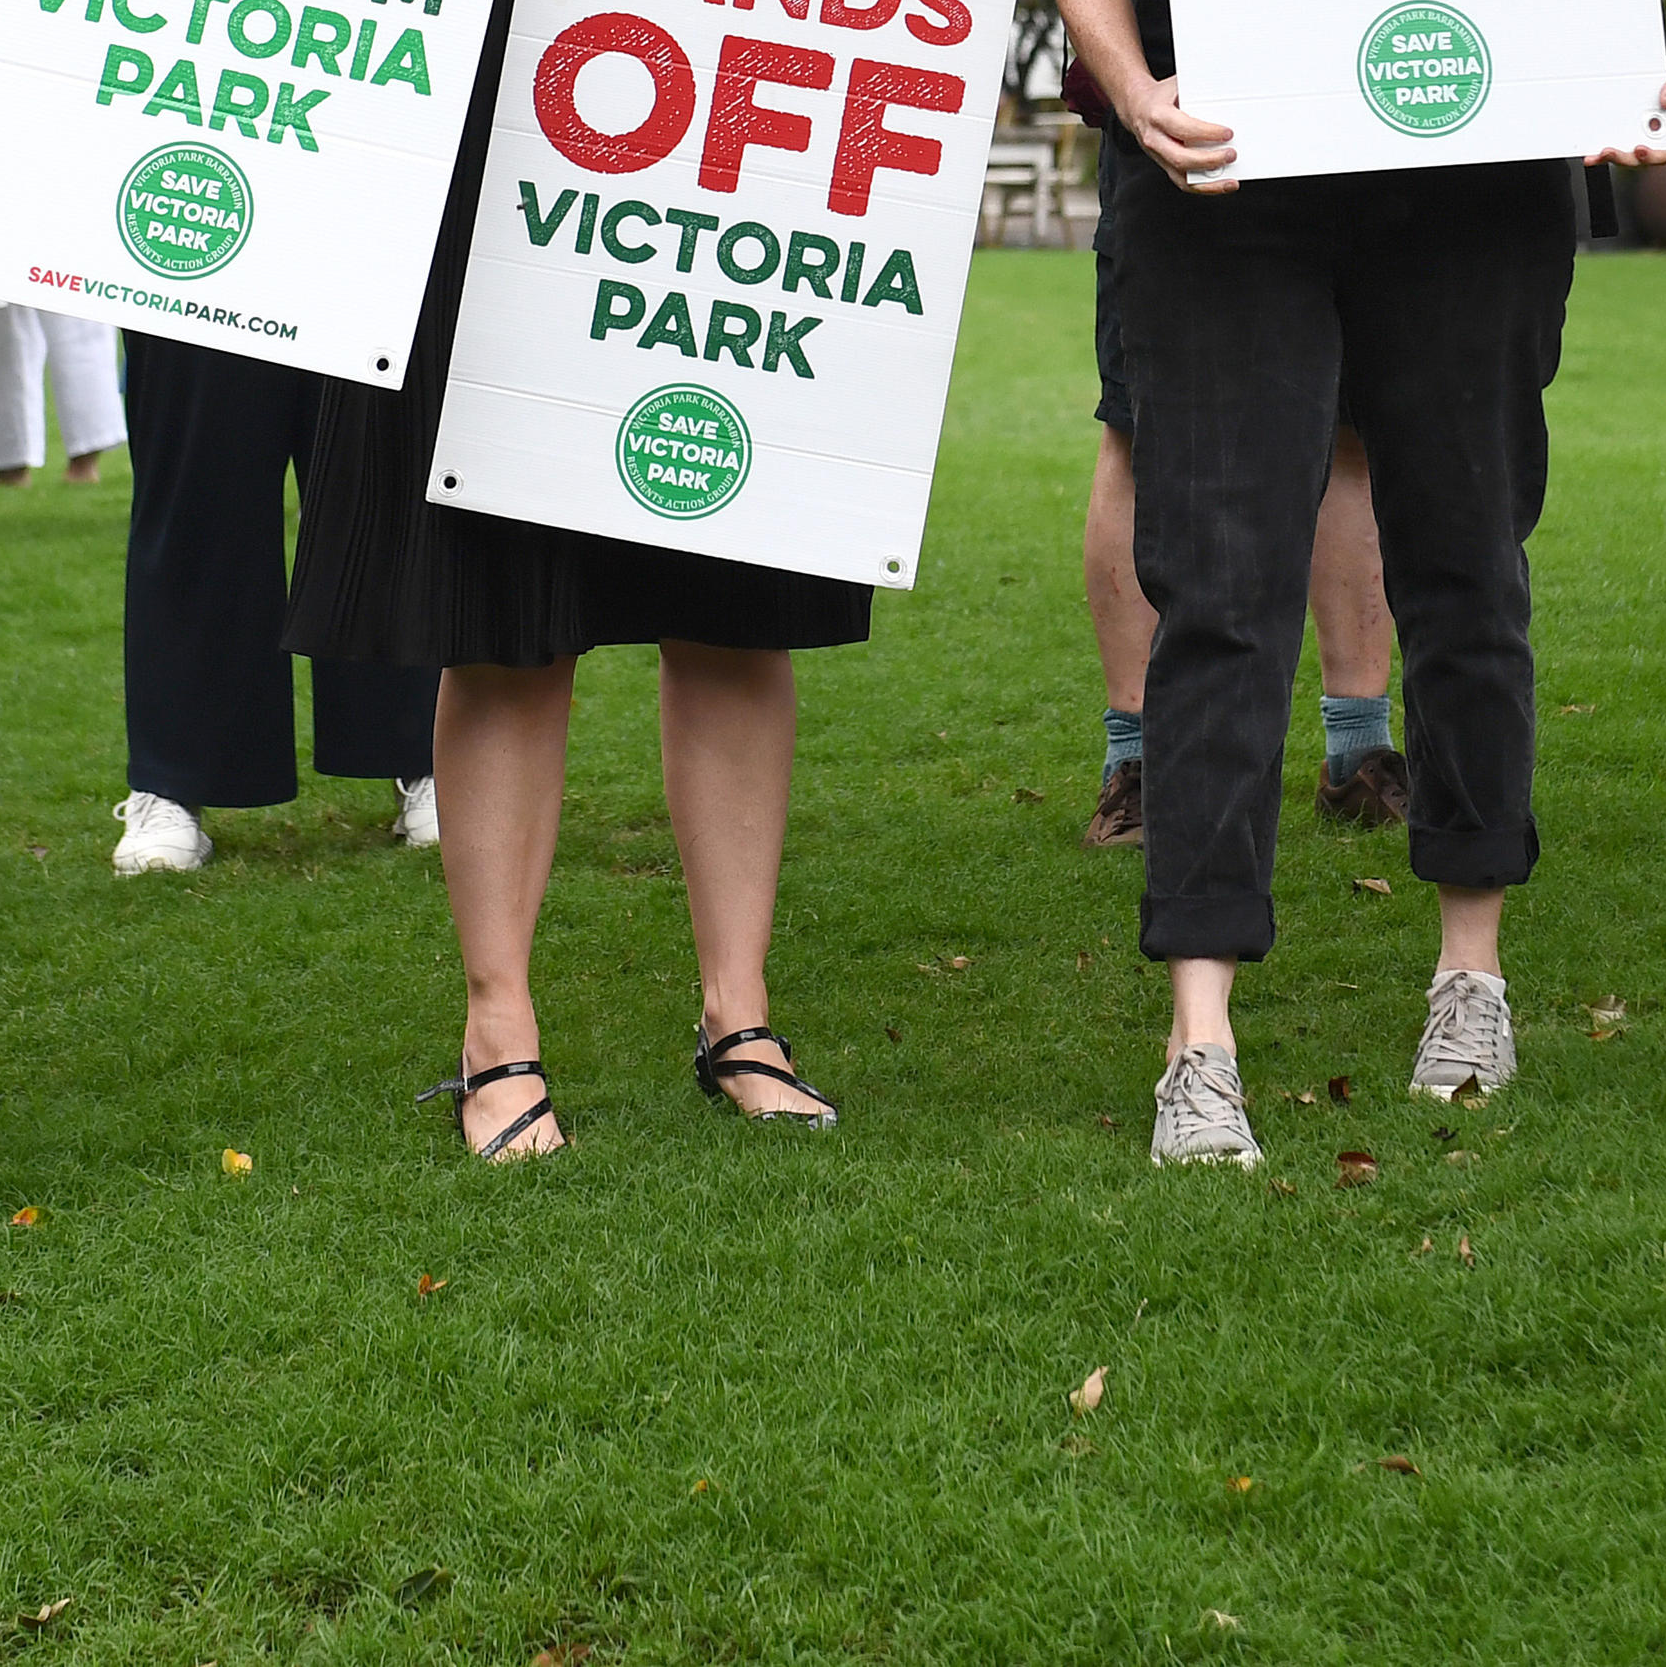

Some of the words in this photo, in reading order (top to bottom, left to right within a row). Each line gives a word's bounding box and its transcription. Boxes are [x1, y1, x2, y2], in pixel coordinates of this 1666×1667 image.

[1368, 20, 1400, 60] VICTORIA
[1399, 11, 1427, 23] PARK
[1391, 32, 1453, 53] SAVE
[1367, 56, 1482, 81] VICTORIA
[95, 43, 331, 153] PARK
[533, 12, 965, 216] OFF
[1372, 86, 1419, 126] RESIDENTS
[1422, 110, 1460, 127] ACTION
[1459, 79, 1481, 112] GROUP
[1395, 84, 1459, 106] PARK
[134, 155, 176, 187] VICTORIA
[178, 152, 205, 163] PARK
[205, 157, 243, 209] BARRAMBIN
[161, 170, 223, 200] SAVE
[130, 189, 240, 232] VICTORIA
[127, 213, 163, 263] RESIDENTS
[163, 258, 203, 269] ACTION
[205, 234, 234, 263] GROUP
[147, 221, 212, 252] PARK
[518, 181, 923, 315] VICTORIA
[28, 266, 298, 340] SAVEVICTORIAPARK.COM
[589, 279, 823, 380] PARK
[632, 396, 671, 430] VICTORIA
[673, 394, 700, 405] PARK
[658, 412, 719, 440] SAVE
[629, 433, 739, 471] VICTORIA
[626, 456, 664, 504] RESIDENTS
[665, 498, 705, 510] ACTION
[707, 474, 734, 502] GROUP
[647, 463, 710, 491] PARK
